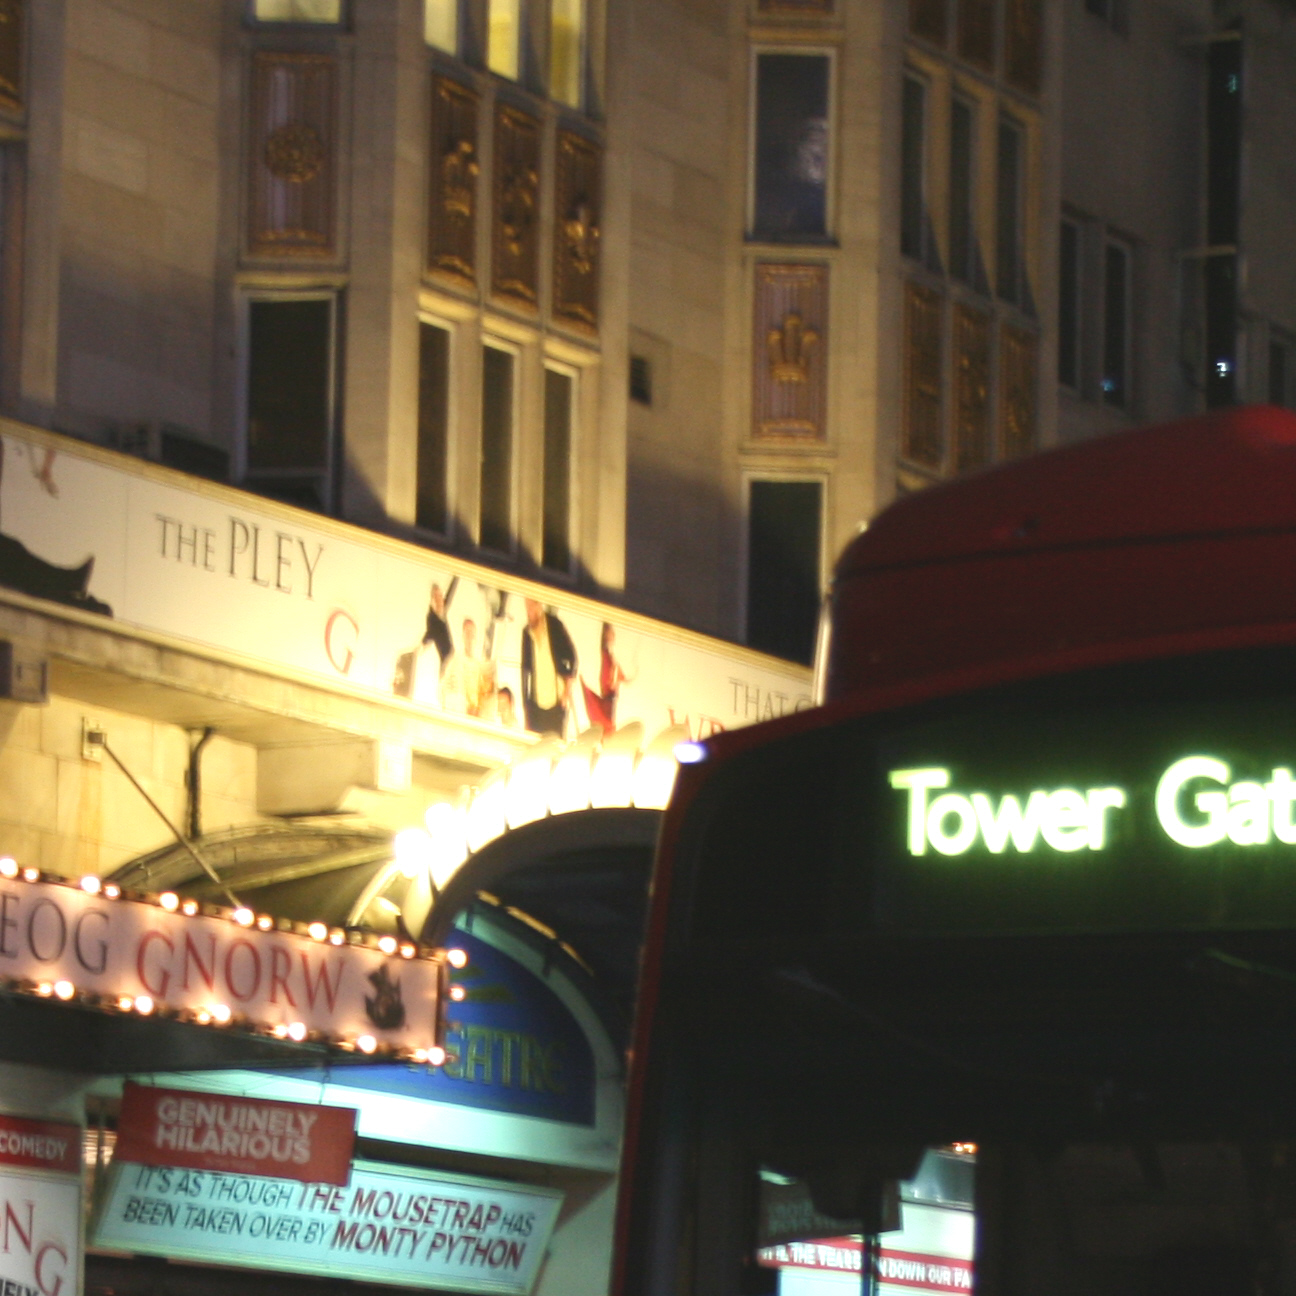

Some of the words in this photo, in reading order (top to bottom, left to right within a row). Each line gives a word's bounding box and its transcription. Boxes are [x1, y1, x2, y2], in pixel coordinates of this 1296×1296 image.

[155, 513, 216, 572] THE
[228, 515, 325, 602] PLEY
[323, 606, 360, 675] G
[728, 676, 789, 724] THAT
[890, 767, 1124, 857] Tower
[135, 928, 346, 1016] GNORW
[155, 1125, 311, 1165] HILARIOUS
[157, 1097, 318, 1143] GENUINELY
[124, 1200, 178, 1227] BEEN
[184, 1208, 246, 1236] TAKEN
[249, 1215, 299, 1243] OVER
[302, 1221, 331, 1246] BY
[331, 1222, 422, 1261] MONTY
[426, 1232, 526, 1271] PYTHON
[134, 1166, 174, 1193] IT'S
[177, 1173, 204, 1199] AS
[209, 1177, 291, 1207] THOUGH
[297, 1184, 344, 1214] THE
[350, 1188, 502, 1234] MOUSETRAP
[504, 1212, 535, 1238] HAS
[817, 1246, 863, 1271] TEARS
[888, 1259, 925, 1283] DOWN
[929, 1266, 952, 1287] OUR
